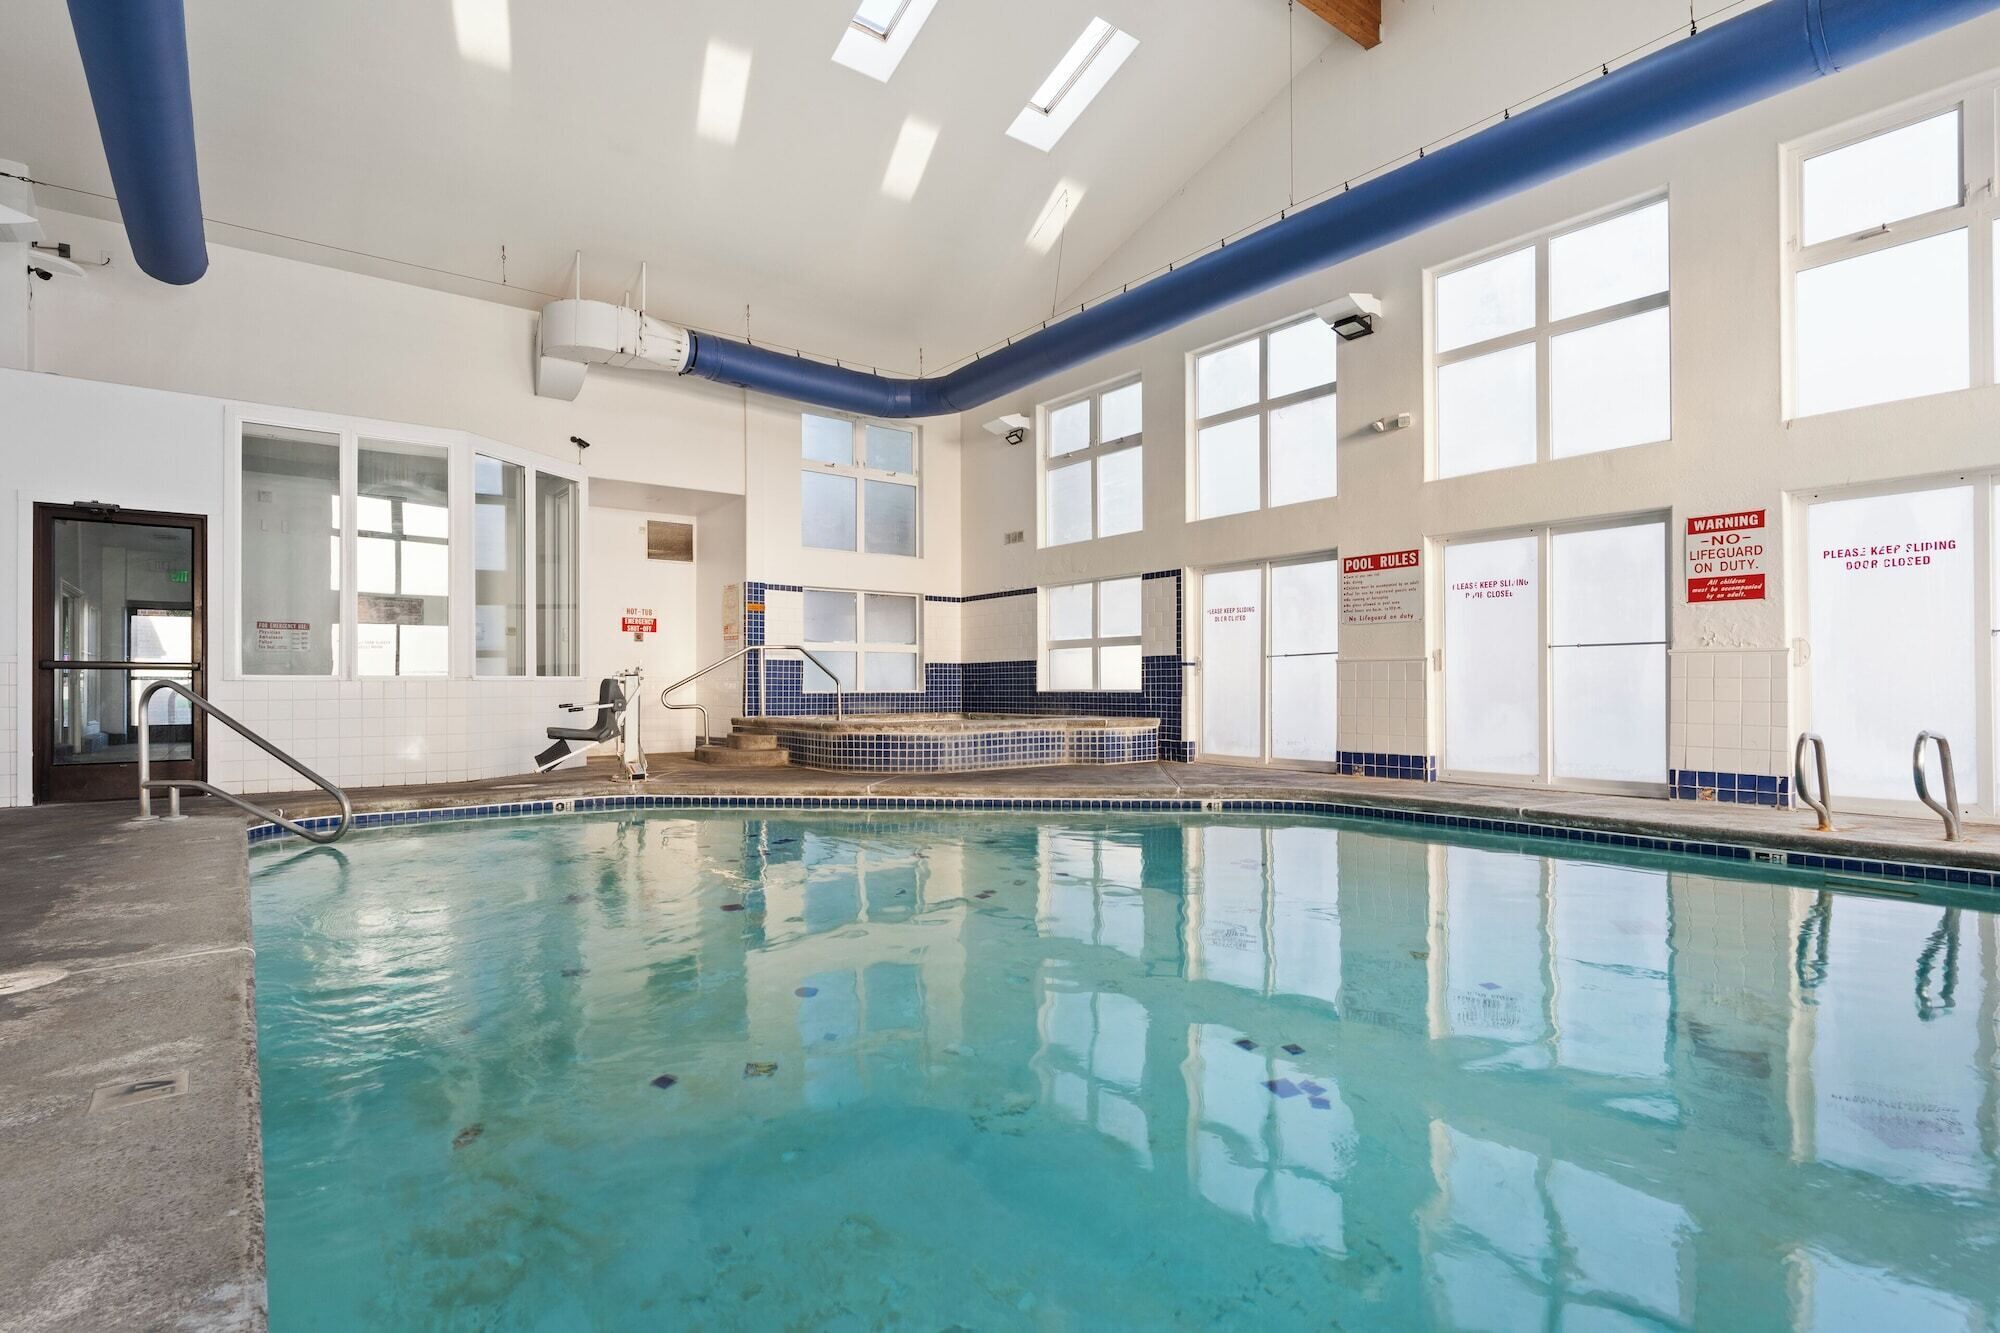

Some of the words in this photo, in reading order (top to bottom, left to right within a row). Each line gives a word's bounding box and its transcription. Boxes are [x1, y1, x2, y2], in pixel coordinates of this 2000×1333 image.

[1694, 514, 1758, 531] WARNING
[1690, 545, 1762, 560] LIFEGUARD
[1871, 545, 1900, 556] KEEP
[1906, 540, 1956, 553] SLIDING
[1346, 558, 1374, 571] POOL
[1380, 552, 1417, 567] RULES
[1695, 563, 1712, 573] ON
[1720, 559, 1758, 571] DUTY.
[1846, 560, 1878, 570] DOOR
[1884, 556, 1931, 567] CLOSED
